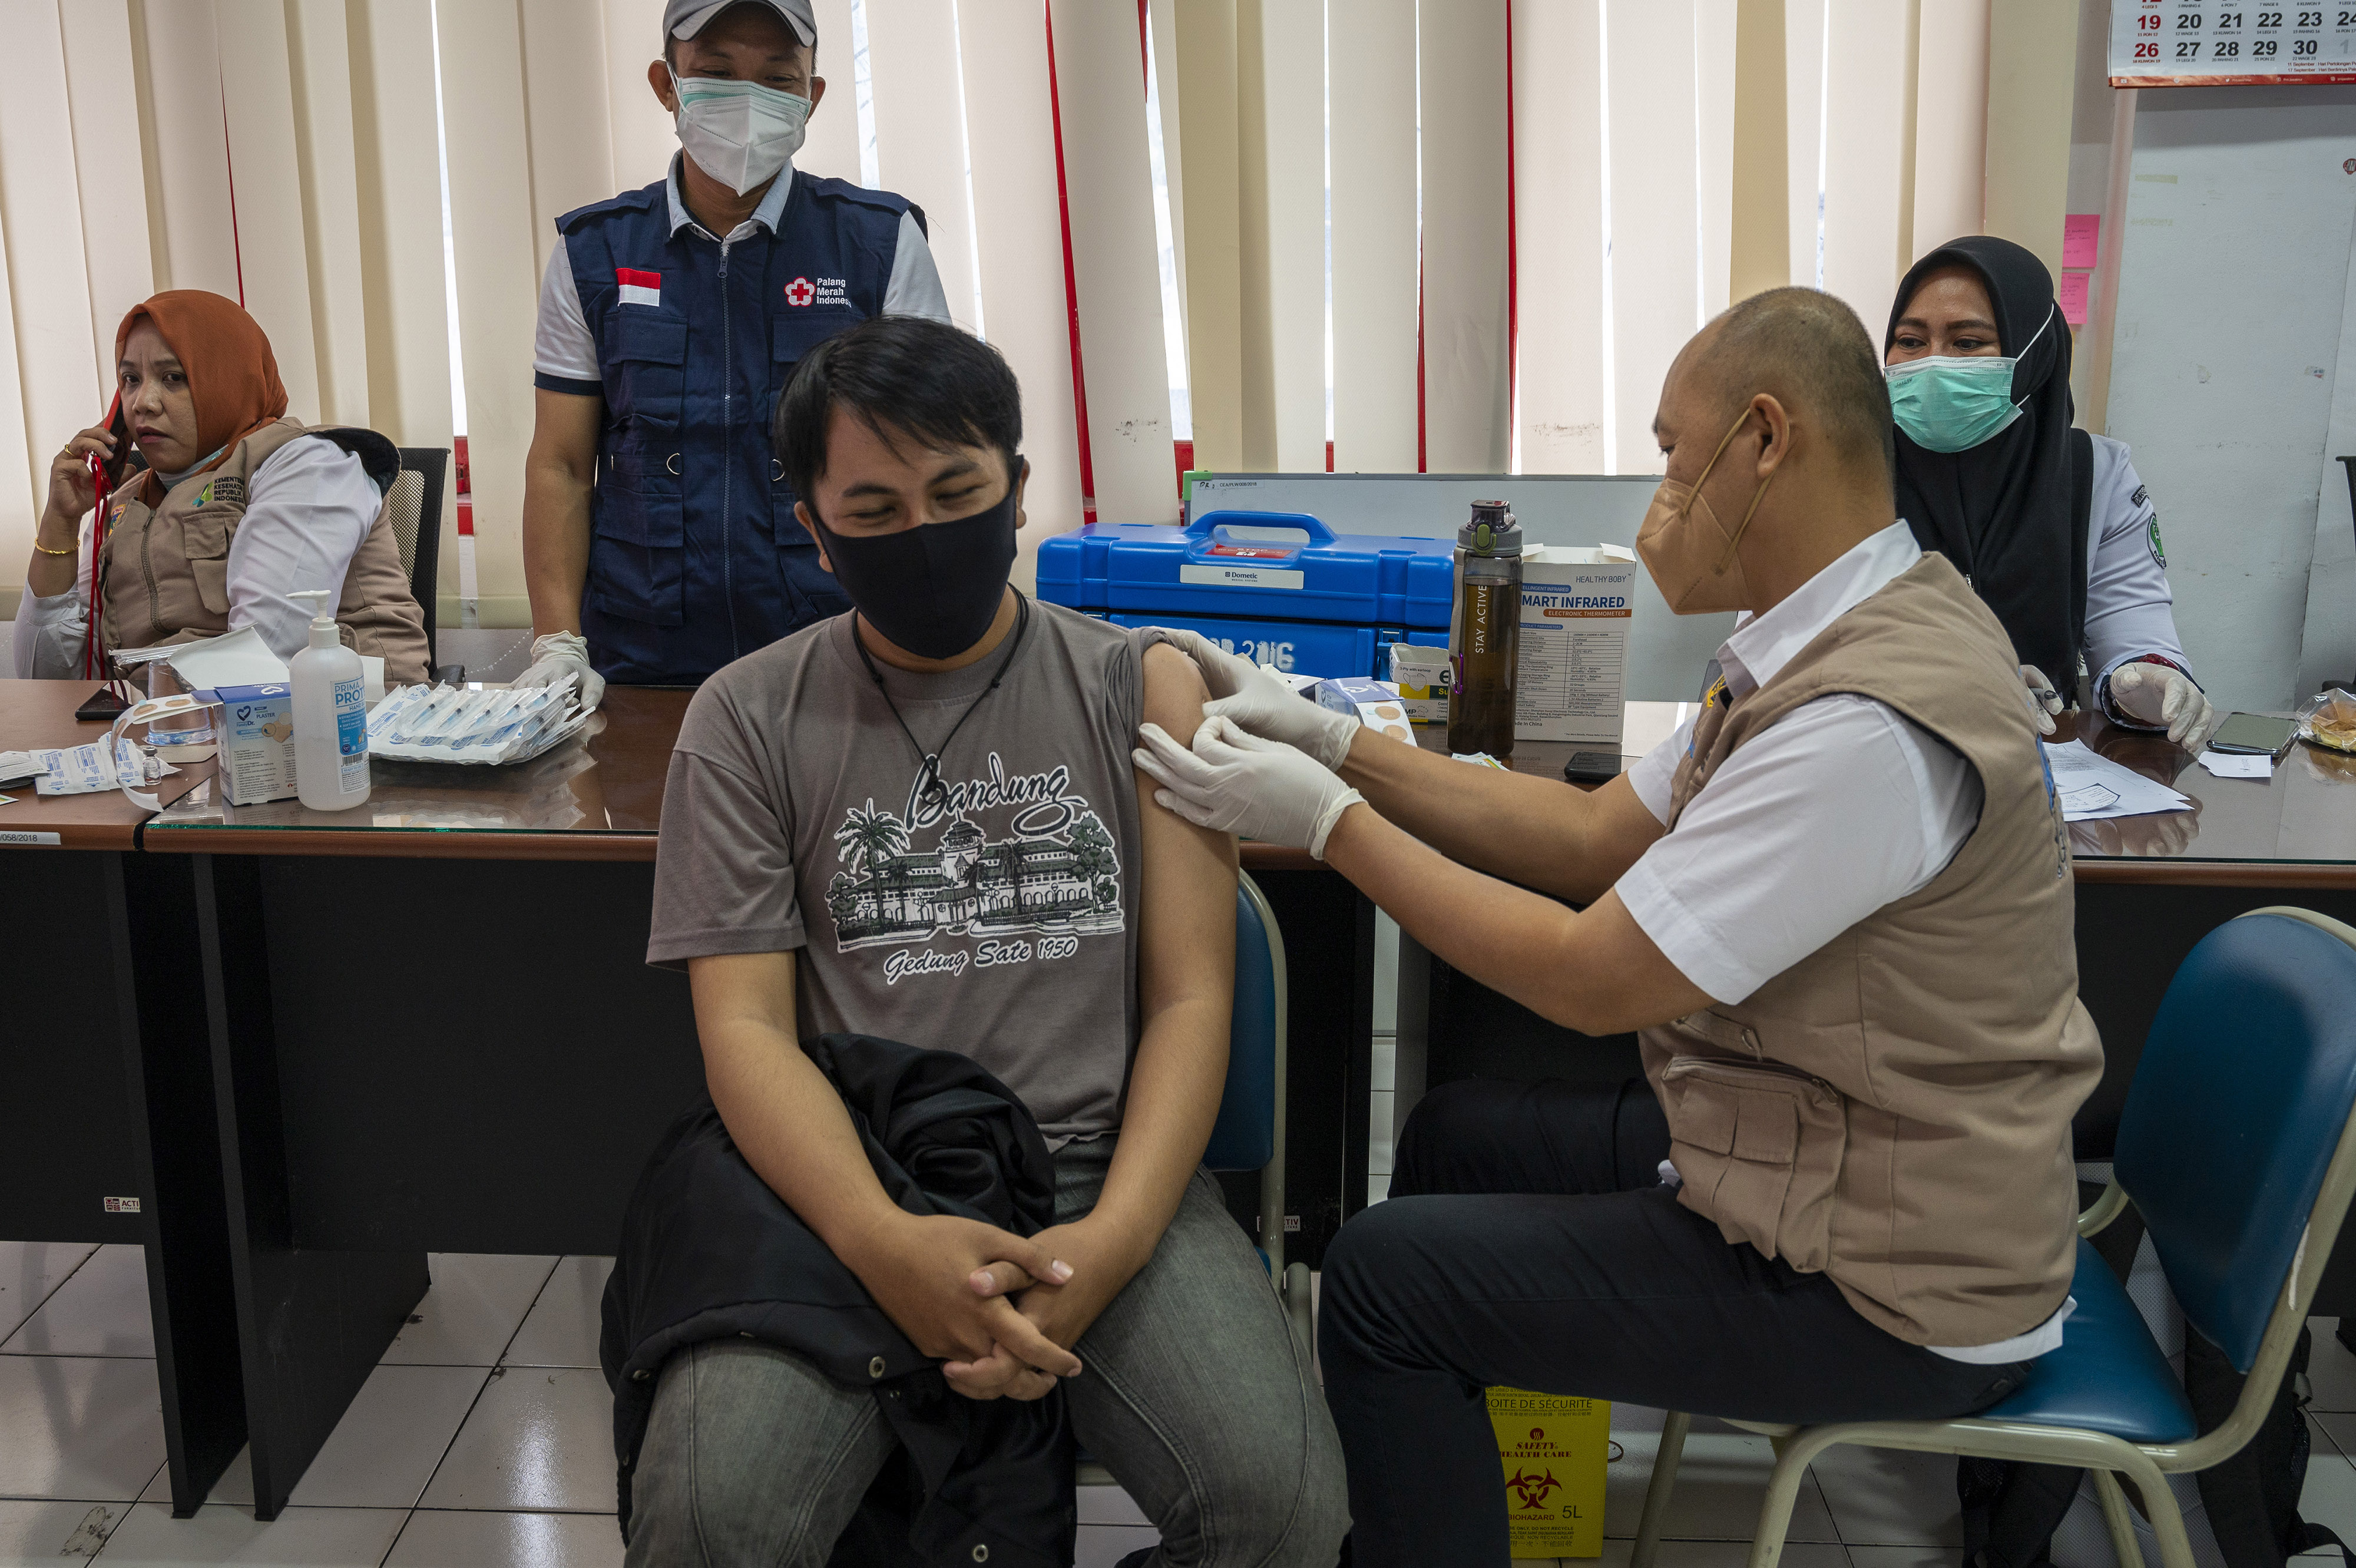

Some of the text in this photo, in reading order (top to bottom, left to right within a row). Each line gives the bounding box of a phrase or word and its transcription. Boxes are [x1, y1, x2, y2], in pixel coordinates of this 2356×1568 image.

[2137, 11, 2356, 29] 19 20 21 22 23 24
[2134, 42, 2159, 57] 26
[2176, 42, 2201, 57] 27
[2214, 41, 2239, 57] 28
[2252, 41, 2277, 55] 29
[2293, 40, 2318, 55] 30
[817, 277, 846, 287] Palang
[817, 287, 844, 296] Merah
[214, 476, 245, 486] KEMENTE
[1521, 595, 1625, 608] MART INFRARED
[1475, 584, 1487, 654] STAY ACTIVE
[334, 682, 360, 693] PRIMA
[904, 752, 1088, 837] Bandung
[884, 937, 1078, 985] Gedung Sate 1950
[1486, 1397, 1593, 1408] BOITE DE SÉCURITÉ
[1562, 1505, 1583, 1519] 5L
